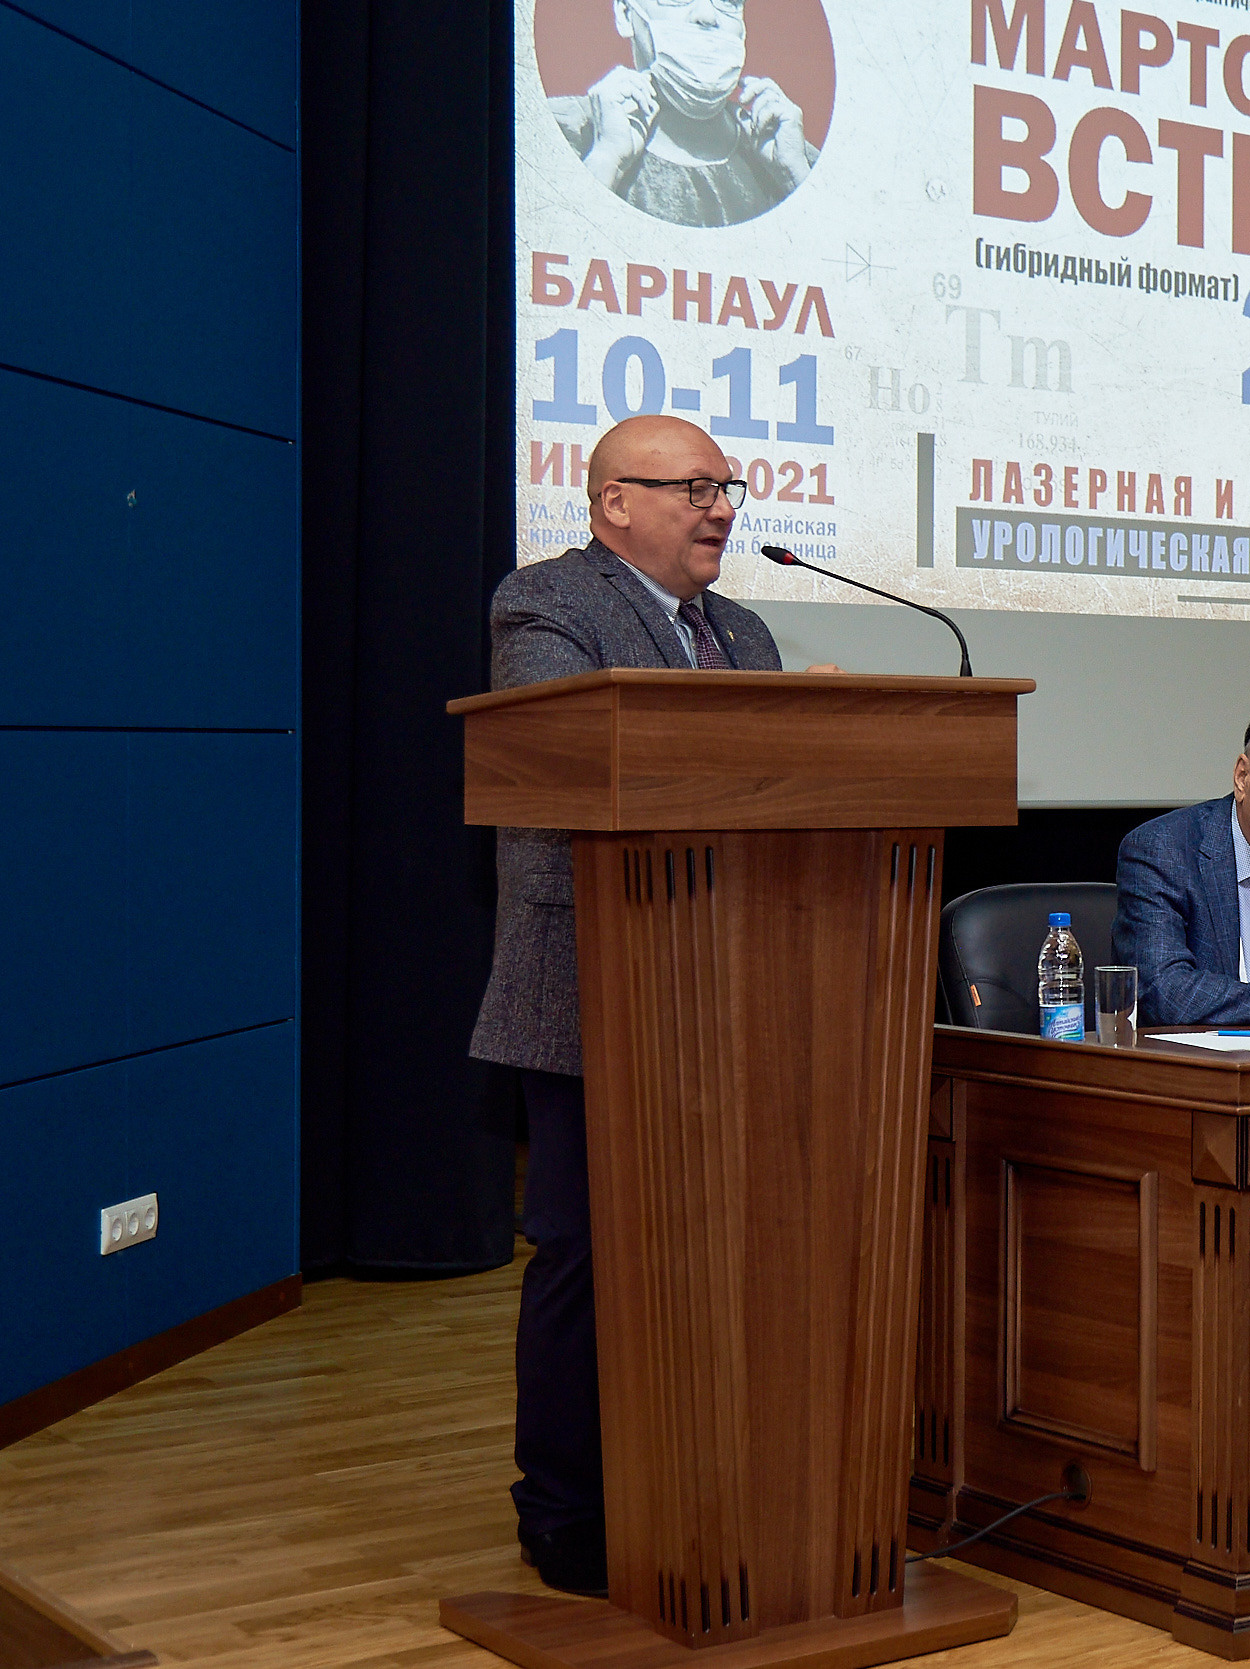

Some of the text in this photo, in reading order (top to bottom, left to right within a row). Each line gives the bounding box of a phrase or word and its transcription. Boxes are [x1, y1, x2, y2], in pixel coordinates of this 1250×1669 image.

[532, 251, 835, 339] БАРНАУЛ
[975, 237, 1239, 302] (гибридный формат)
[532, 328, 834, 446] 10-11
[969, 458, 1192, 517] ЛАЗЕРНАЯ
[1214, 480, 1233, 518] И
[740, 512, 836, 536] Алтайская
[972, 518, 1250, 576] УРОЛОГИЧЕСКАЯ
